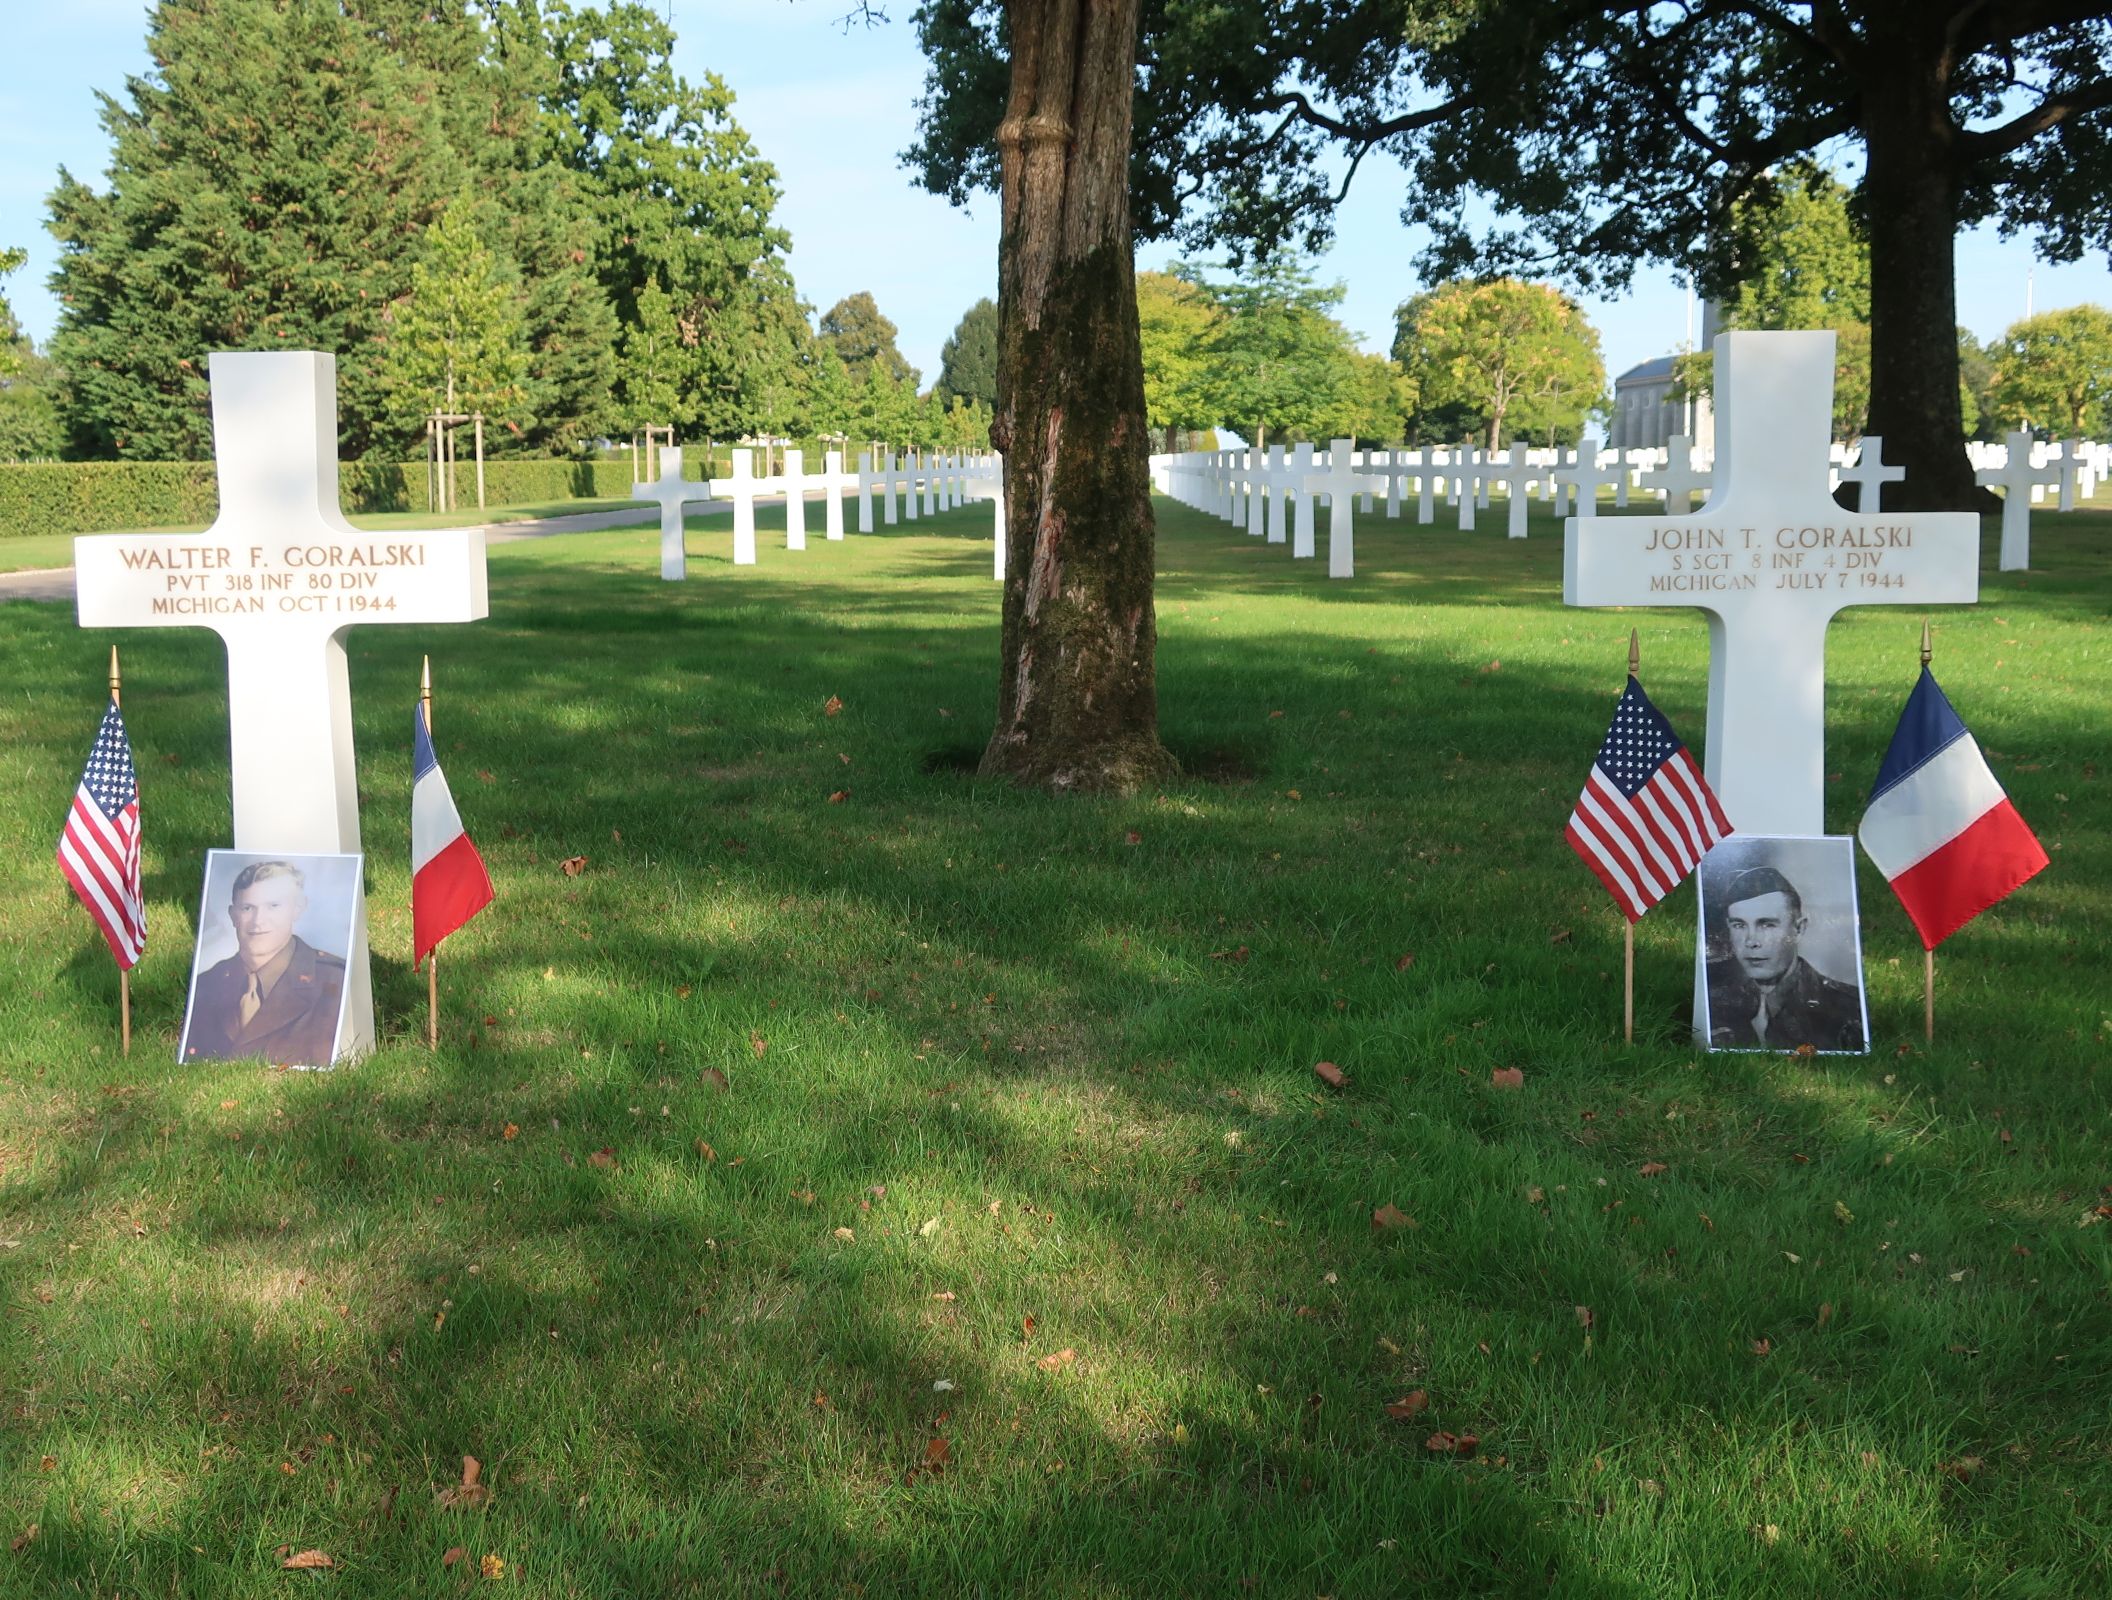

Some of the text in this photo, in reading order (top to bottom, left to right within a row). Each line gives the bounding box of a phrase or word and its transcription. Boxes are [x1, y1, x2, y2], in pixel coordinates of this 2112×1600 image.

[1646, 527, 1912, 551] JOHN T. GORALSKI
[119, 544, 424, 570] WALTER F. GORALSKI
[1672, 552, 1883, 570] S SGT 8 INF 4 DIV
[167, 572, 378, 592] PVT 318 INF 80 DIV
[1650, 573, 1904, 591] MICHIGAN JULY 7 1944
[152, 597, 264, 614] MICHIGAN
[279, 596, 328, 612] OCT
